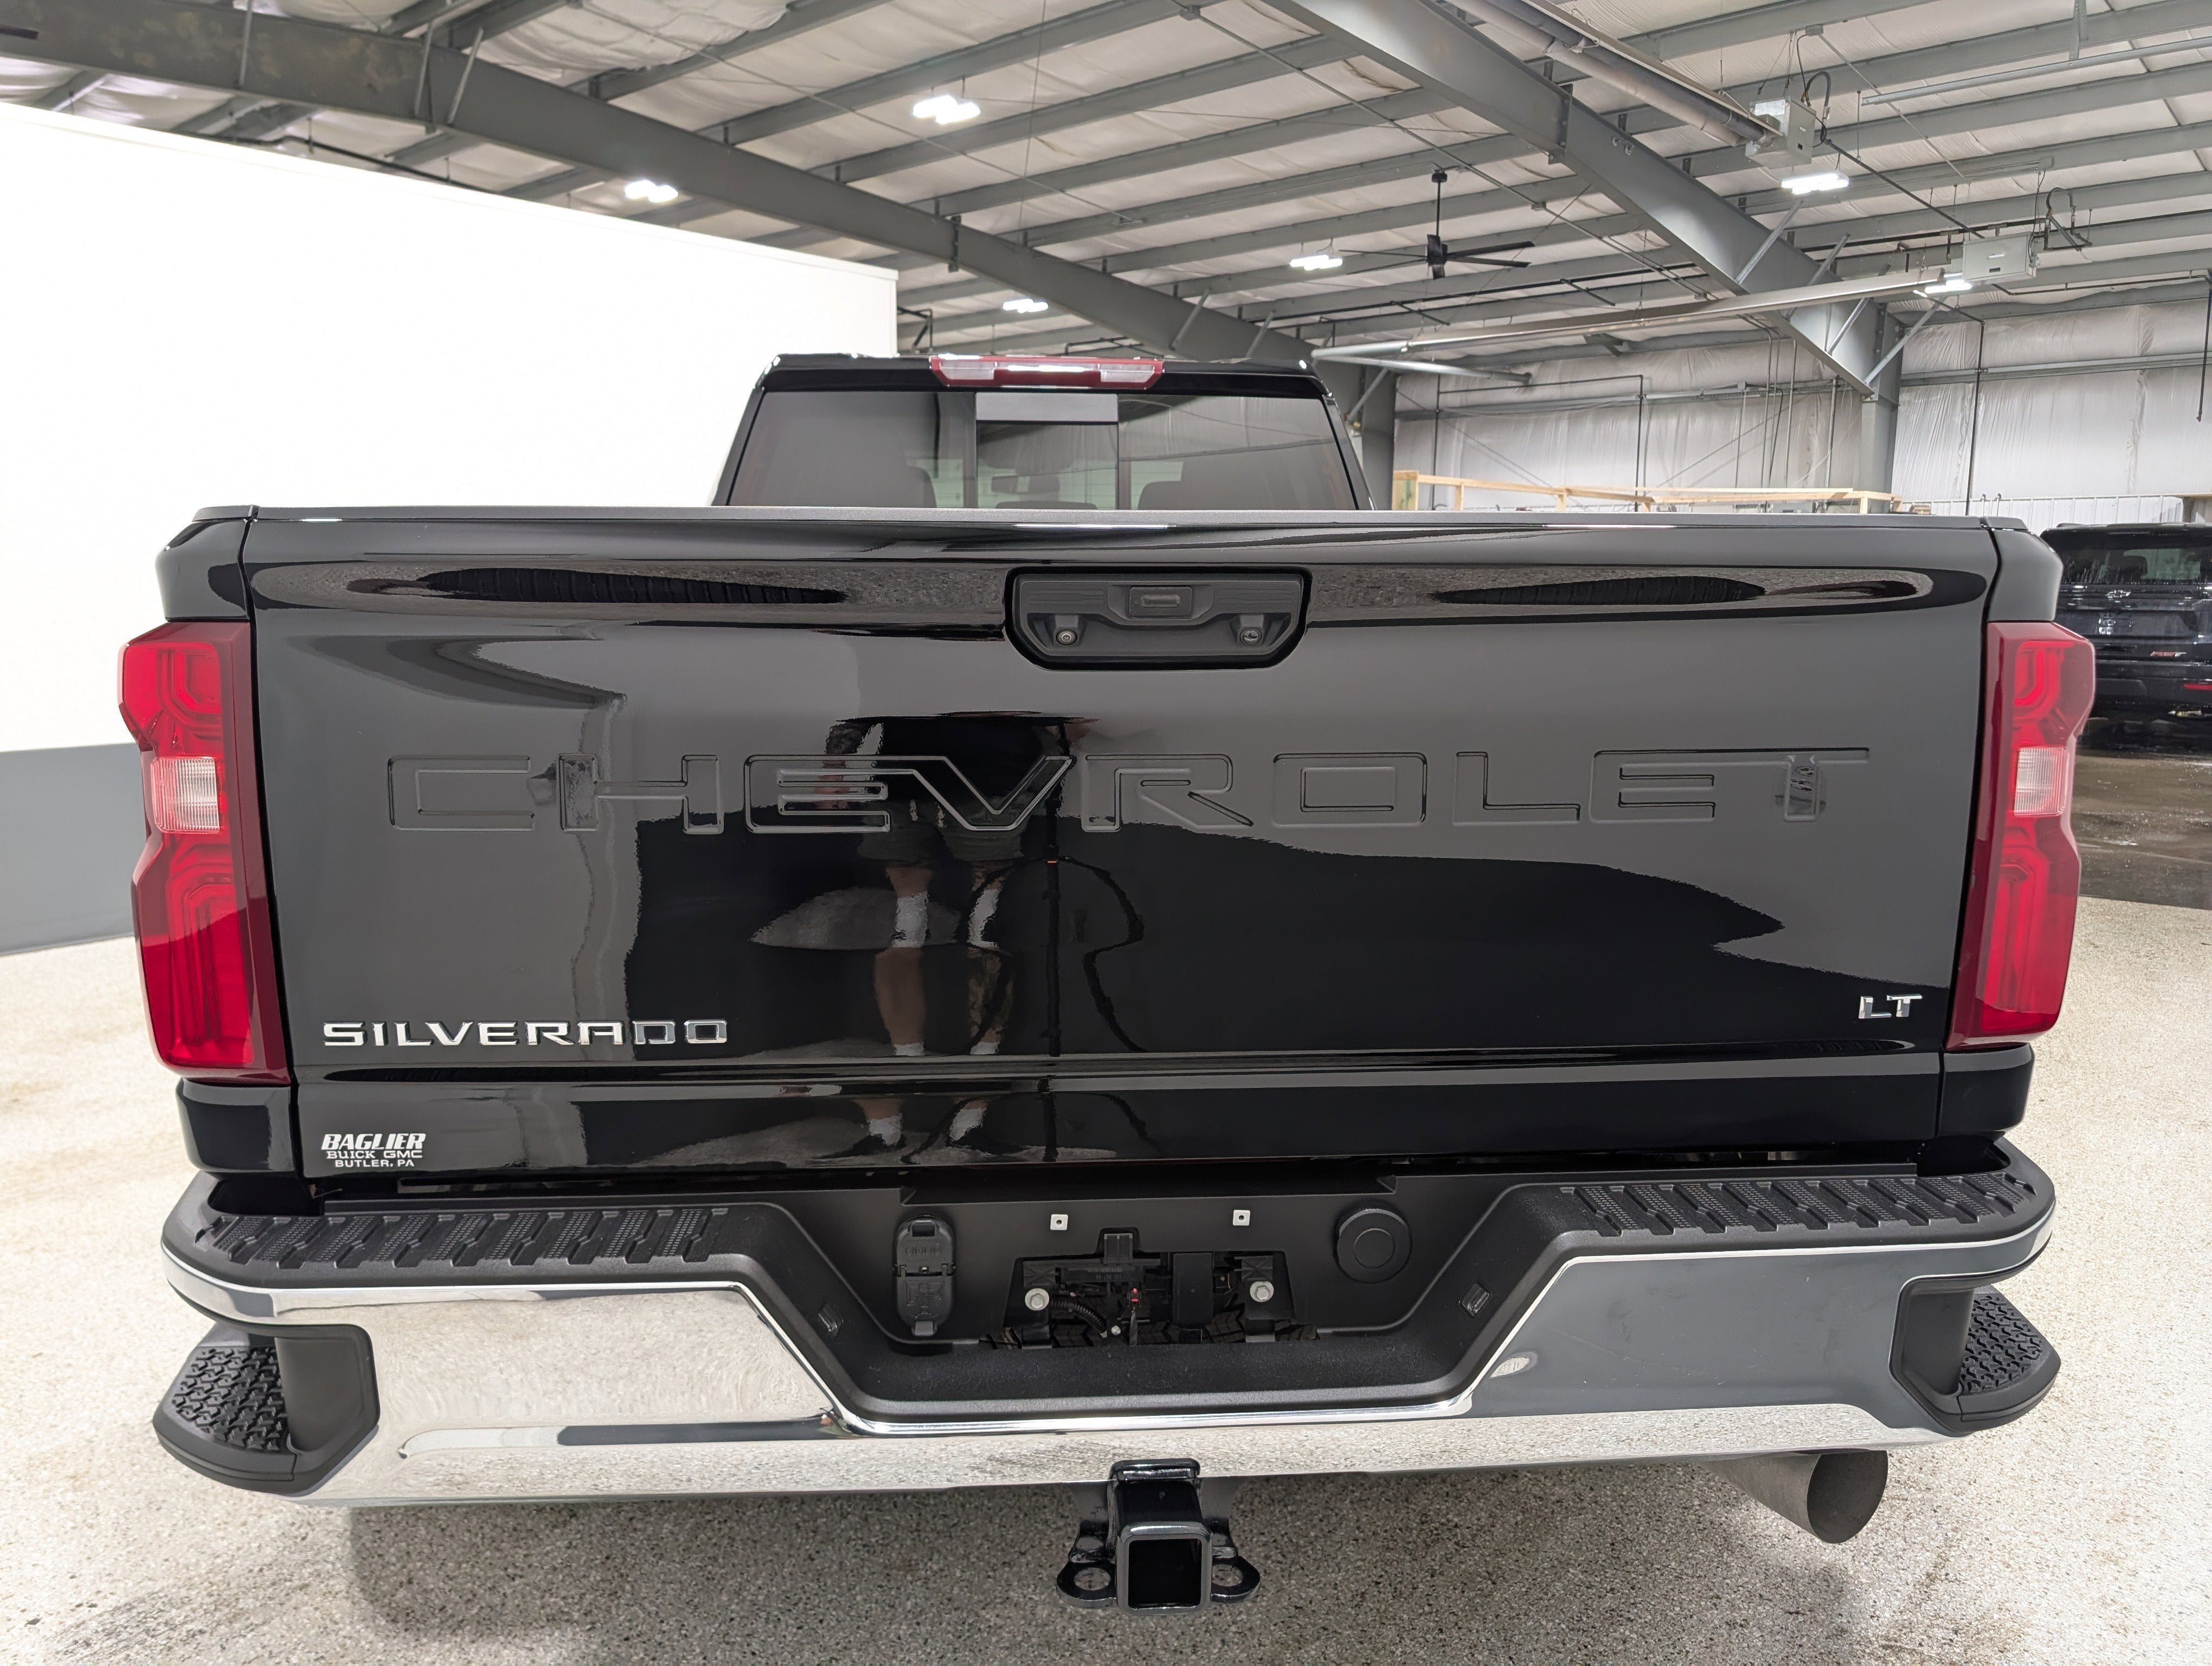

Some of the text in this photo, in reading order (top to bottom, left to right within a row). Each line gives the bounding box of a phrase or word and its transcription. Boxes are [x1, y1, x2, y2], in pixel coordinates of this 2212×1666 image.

[388, 747, 1869, 834] CHEVROLET
[1859, 993, 1922, 1019] LT
[324, 1020, 728, 1047] SILVERADO
[321, 1133, 426, 1150] BAGLIER
[326, 1150, 423, 1159] BUICK GMC
[397, 1159, 415, 1167] PA
